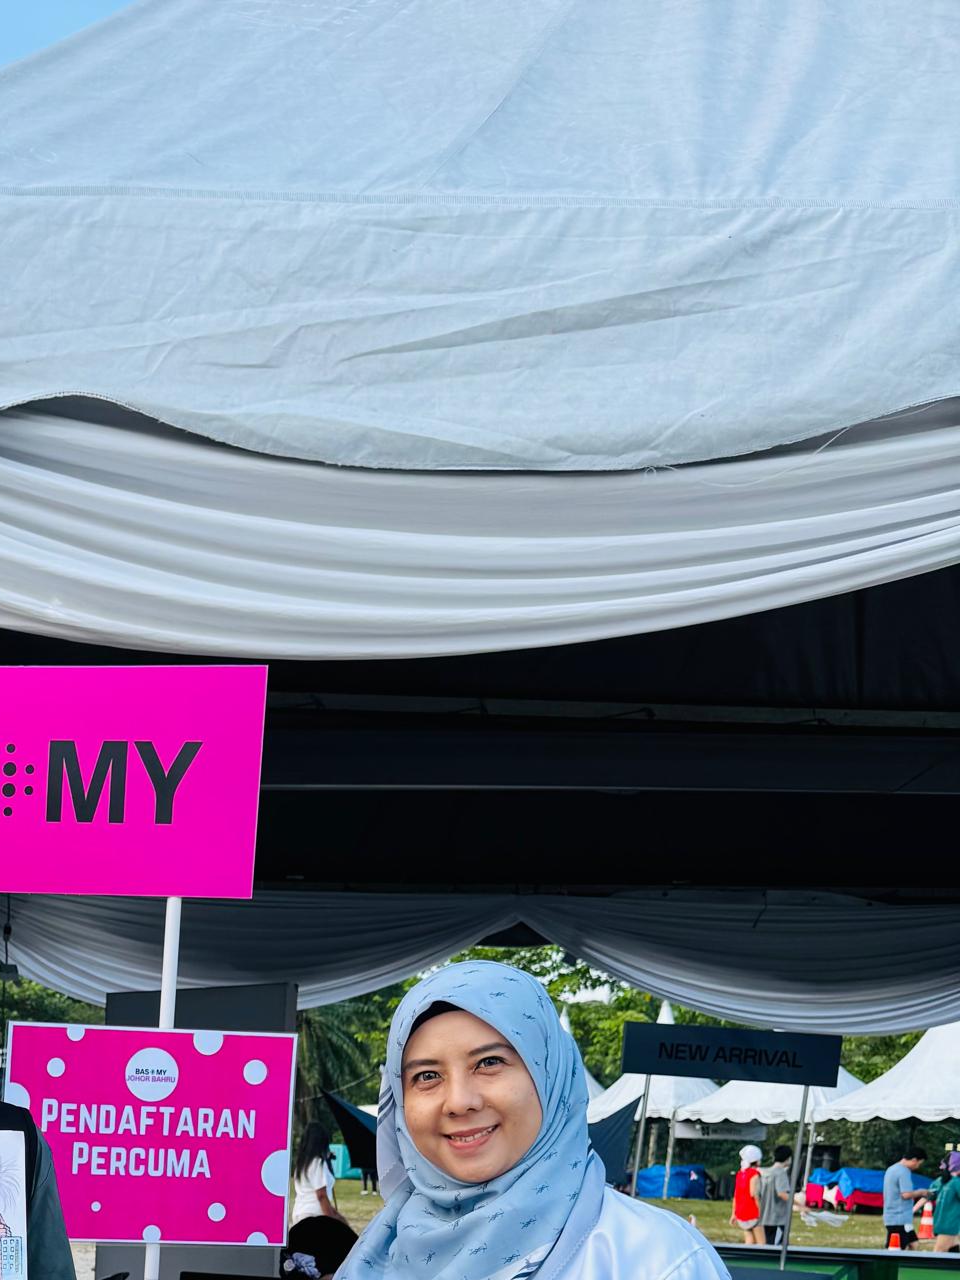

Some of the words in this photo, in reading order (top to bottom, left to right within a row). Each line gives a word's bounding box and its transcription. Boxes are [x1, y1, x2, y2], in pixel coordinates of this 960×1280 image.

[45, 739, 203, 825] MY
[658, 1042, 710, 1062] NEW
[713, 1046, 804, 1069] ARRIVAL
[41, 1097, 256, 1139] PENDAFTARAN
[72, 1141, 211, 1178] PERCUMA
